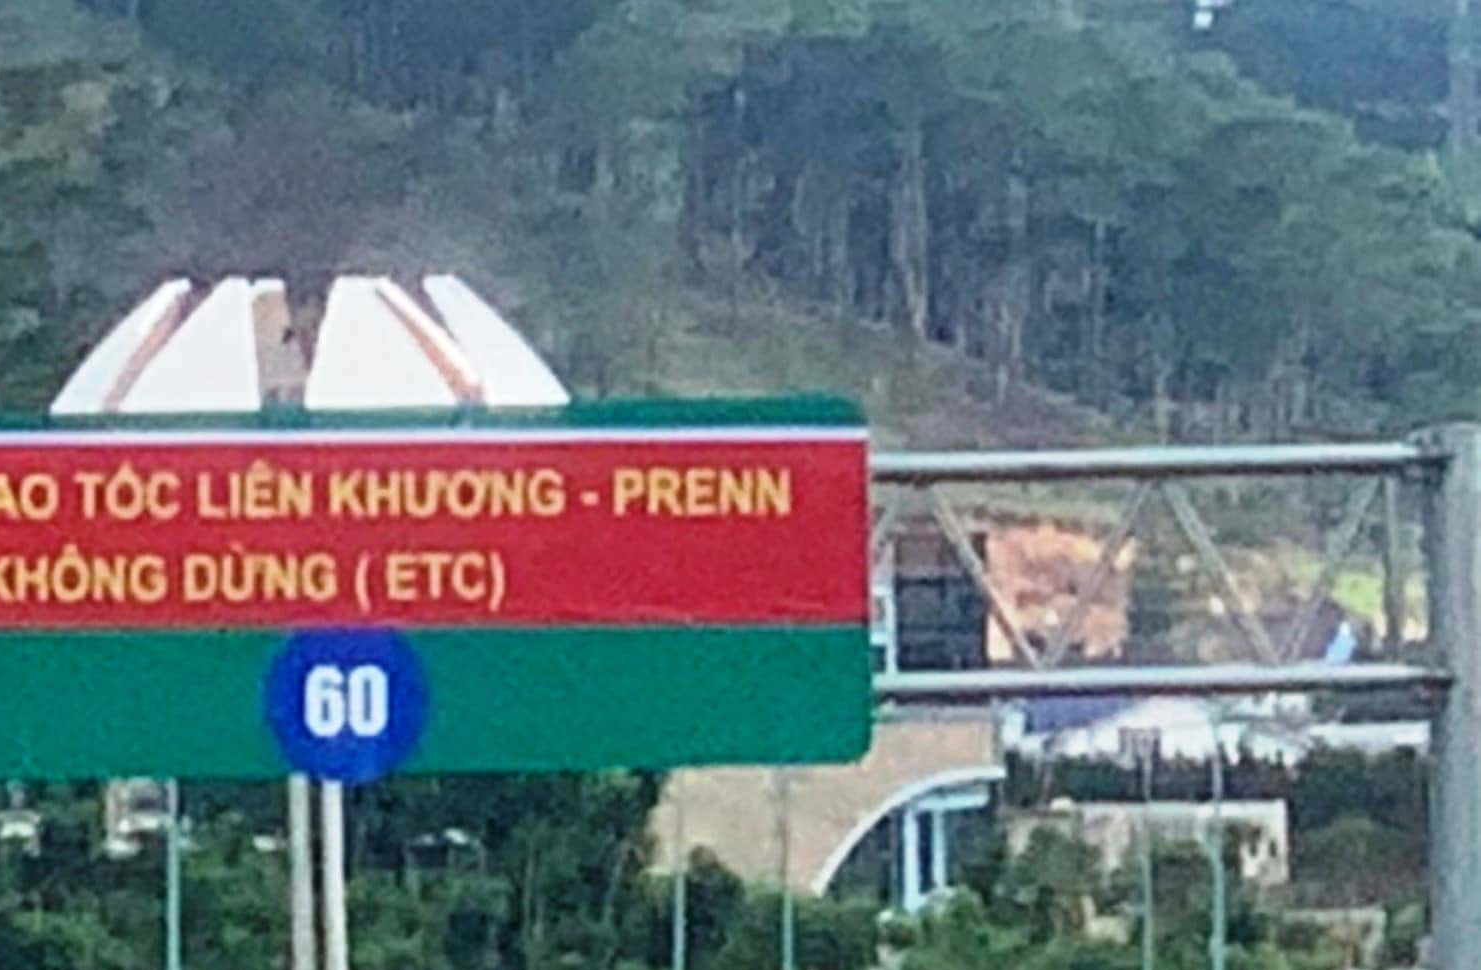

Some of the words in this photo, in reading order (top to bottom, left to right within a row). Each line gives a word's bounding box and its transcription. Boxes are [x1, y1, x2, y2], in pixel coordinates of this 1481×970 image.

[197, 458, 313, 519] LIÊN
[329, 468, 565, 518] KHƯƠNG
[613, 466, 791, 517] PRENN
[183, 540, 337, 602] DỪNG
[303, 664, 389, 738] 60
